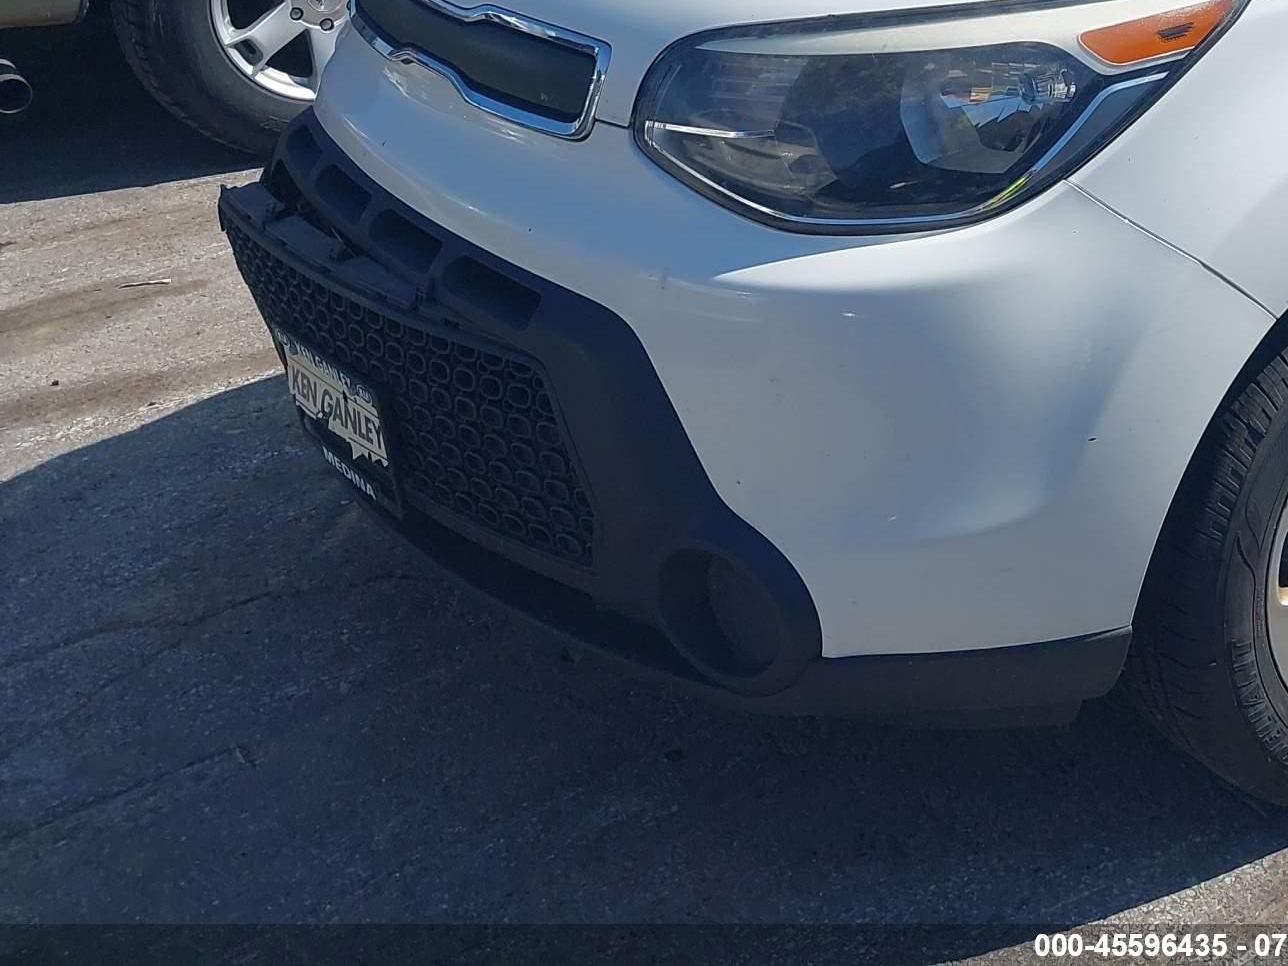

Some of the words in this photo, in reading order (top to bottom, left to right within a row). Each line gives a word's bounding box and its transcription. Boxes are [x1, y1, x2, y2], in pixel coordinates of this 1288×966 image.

[292, 366, 318, 409] KEN
[321, 388, 382, 450] GANLEY
[322, 445, 377, 501] MEDINA
